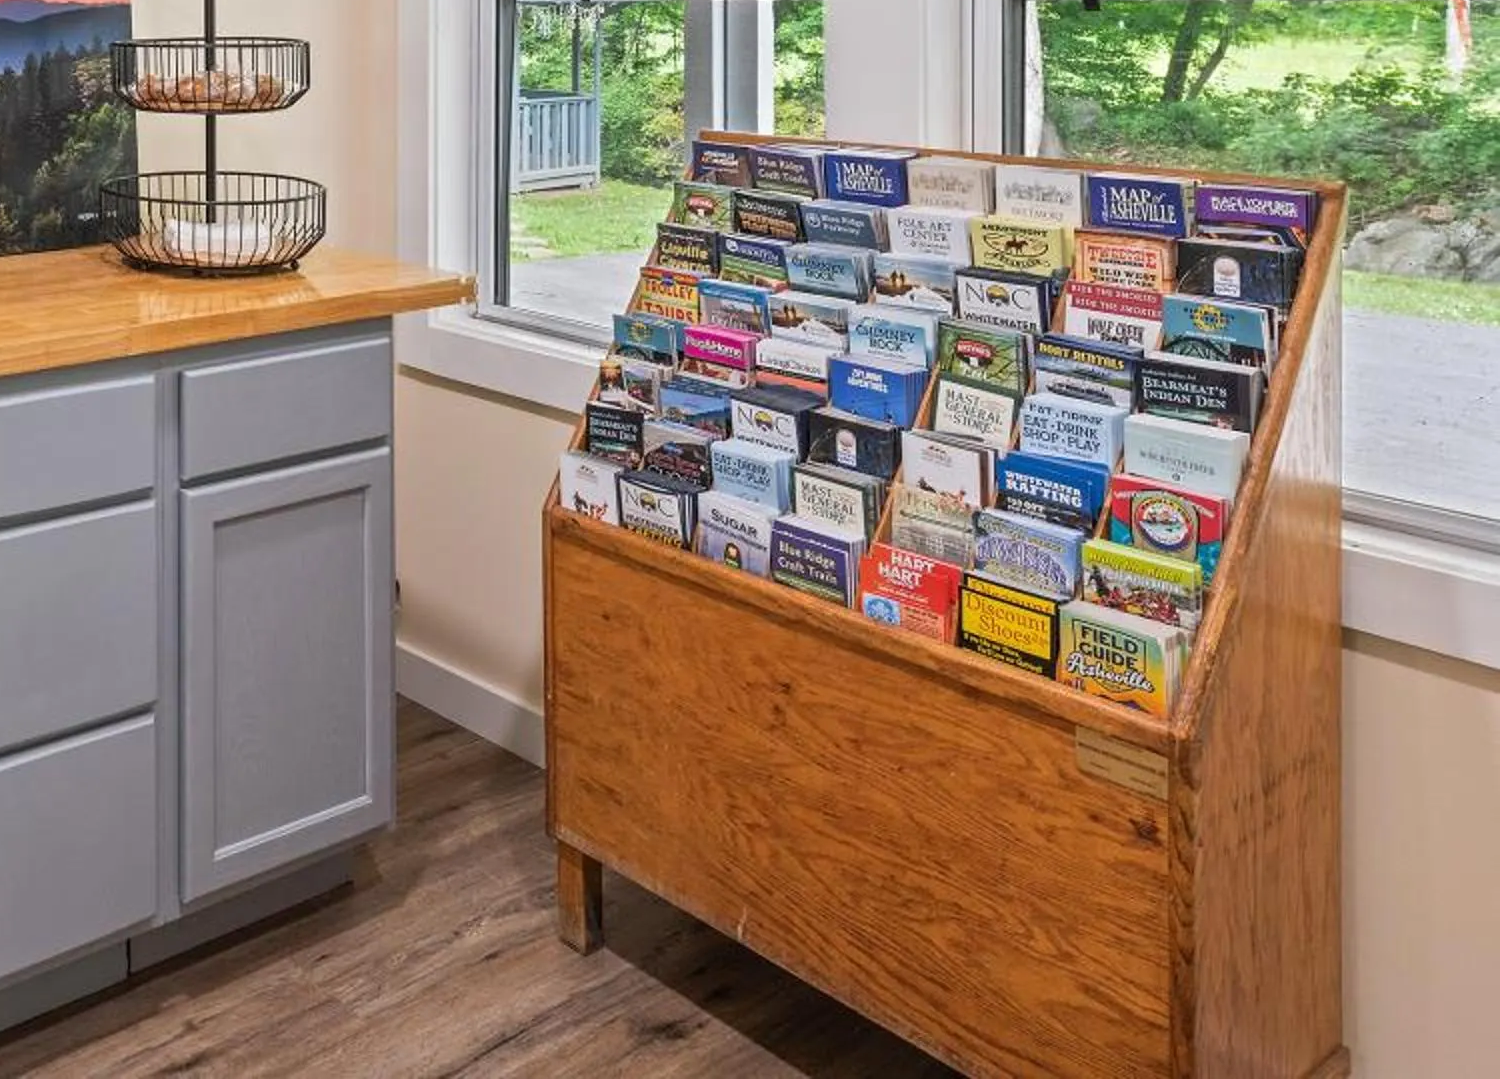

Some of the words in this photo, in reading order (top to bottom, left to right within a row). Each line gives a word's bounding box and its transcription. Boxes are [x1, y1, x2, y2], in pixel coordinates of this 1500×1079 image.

[843, 162, 875, 174] MAP
[1110, 187, 1151, 202] MAP
[1108, 200, 1177, 223] ASHEVILLE
[898, 217, 927, 229] FOLK
[931, 221, 953, 232] ART
[902, 228, 948, 242] CENTER
[792, 257, 845, 274] CHIMNEY
[805, 269, 835, 282] ROCK
[1089, 267, 1121, 279] WILD
[1124, 270, 1156, 282] WEST
[1096, 287, 1114, 297] THE
[1101, 301, 1118, 311] THE
[855, 325, 916, 344] CHIMNEY
[869, 339, 903, 353] ROCK
[1039, 342, 1070, 359] BOAT
[1073, 348, 1125, 370] RENTALS
[1143, 376, 1227, 398] BEARMEAT'S
[946, 389, 981, 408] MAST
[1143, 388, 1191, 404] INDIAN
[1195, 395, 1227, 409] DEN
[946, 402, 1002, 425] GENERAL
[953, 413, 993, 434] STORE
[1024, 415, 1049, 429] EAT
[1055, 419, 1099, 439] DRINK
[1023, 427, 1059, 444] SHOP
[1067, 434, 1100, 453] PLAY
[801, 480, 832, 498] MAST
[1004, 470, 1081, 495] WHITEWATER
[1005, 478, 1083, 508] RAFTING
[801, 494, 854, 515] GENERAL
[711, 508, 758, 538] SUGAR
[779, 540, 802, 558] Blue
[803, 546, 836, 569] Ridge
[891, 552, 936, 574] HART
[778, 556, 806, 575] Craft
[807, 564, 838, 585] Trails
[878, 562, 923, 586] HART
[966, 591, 1046, 633] Discount
[980, 614, 1032, 645] Shoes
[1081, 625, 1139, 654] FIELD
[1079, 641, 1138, 669] GUIDE
[1067, 652, 1155, 693] Asheville
